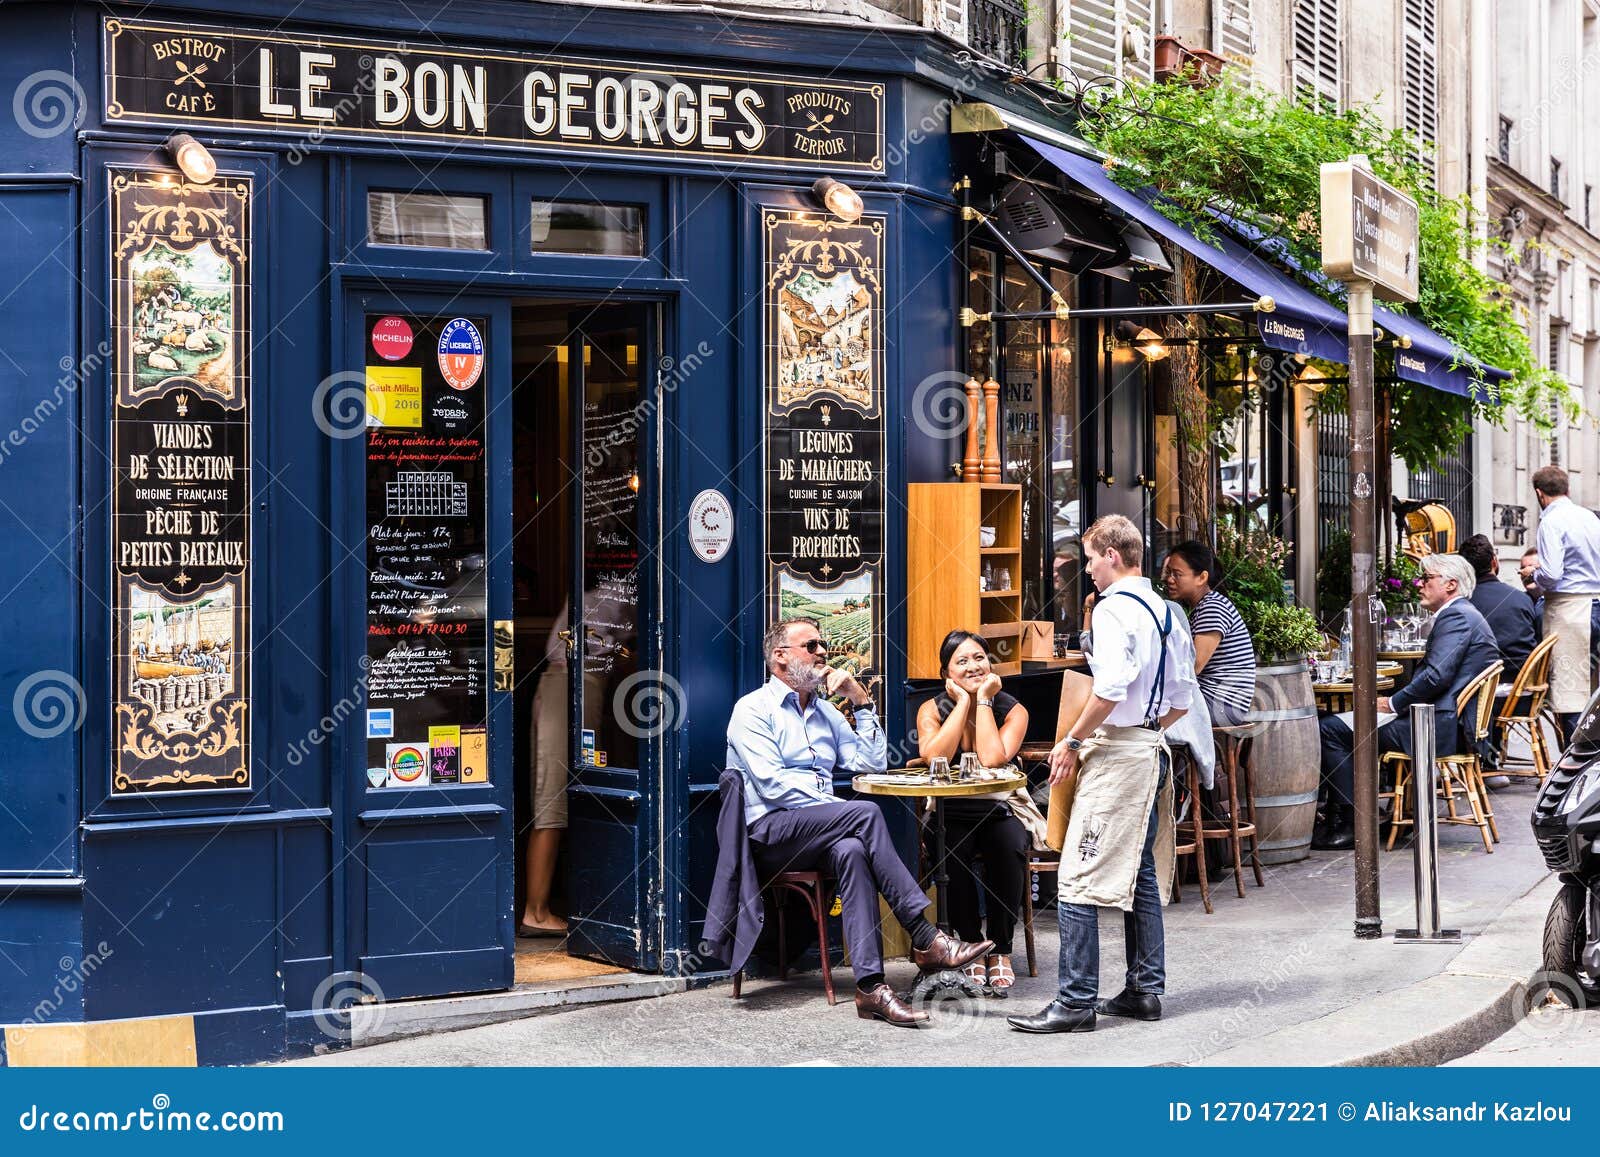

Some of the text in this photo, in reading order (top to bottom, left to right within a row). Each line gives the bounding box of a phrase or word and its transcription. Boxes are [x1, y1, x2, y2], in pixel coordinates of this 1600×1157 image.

[153, 38, 225, 63] BISTROT
[166, 92, 216, 112] CAFÉ
[260, 48, 766, 151] LE BON GEORGES
[787, 91, 851, 116] PRODUITS
[794, 133, 846, 156] TERROIR
[372, 334, 413, 343] MICHELIN
[441, 327, 453, 349] VILLE
[468, 326, 481, 350] PARIS
[1265, 319, 1305, 341] LE BON GEORGES
[455, 357, 466, 368] IV
[395, 400, 420, 409] 2016
[153, 424, 213, 449] VIANDES
[800, 431, 854, 453] LÉGUMES
[130, 453, 234, 480] DE SÉLECTION
[779, 456, 872, 481] DE MARAÎCHERS
[136, 488, 228, 503] ORIGINE FRANÇAISE
[789, 489, 863, 500] CUISINE DE SAISON
[146, 506, 219, 535] PÊCHE DE
[803, 508, 850, 530] VINS DE
[371, 525, 391, 538] Plat
[121, 541, 244, 566] PETITS BATEAUX
[792, 534, 861, 558] PROPRIÉTÉS
